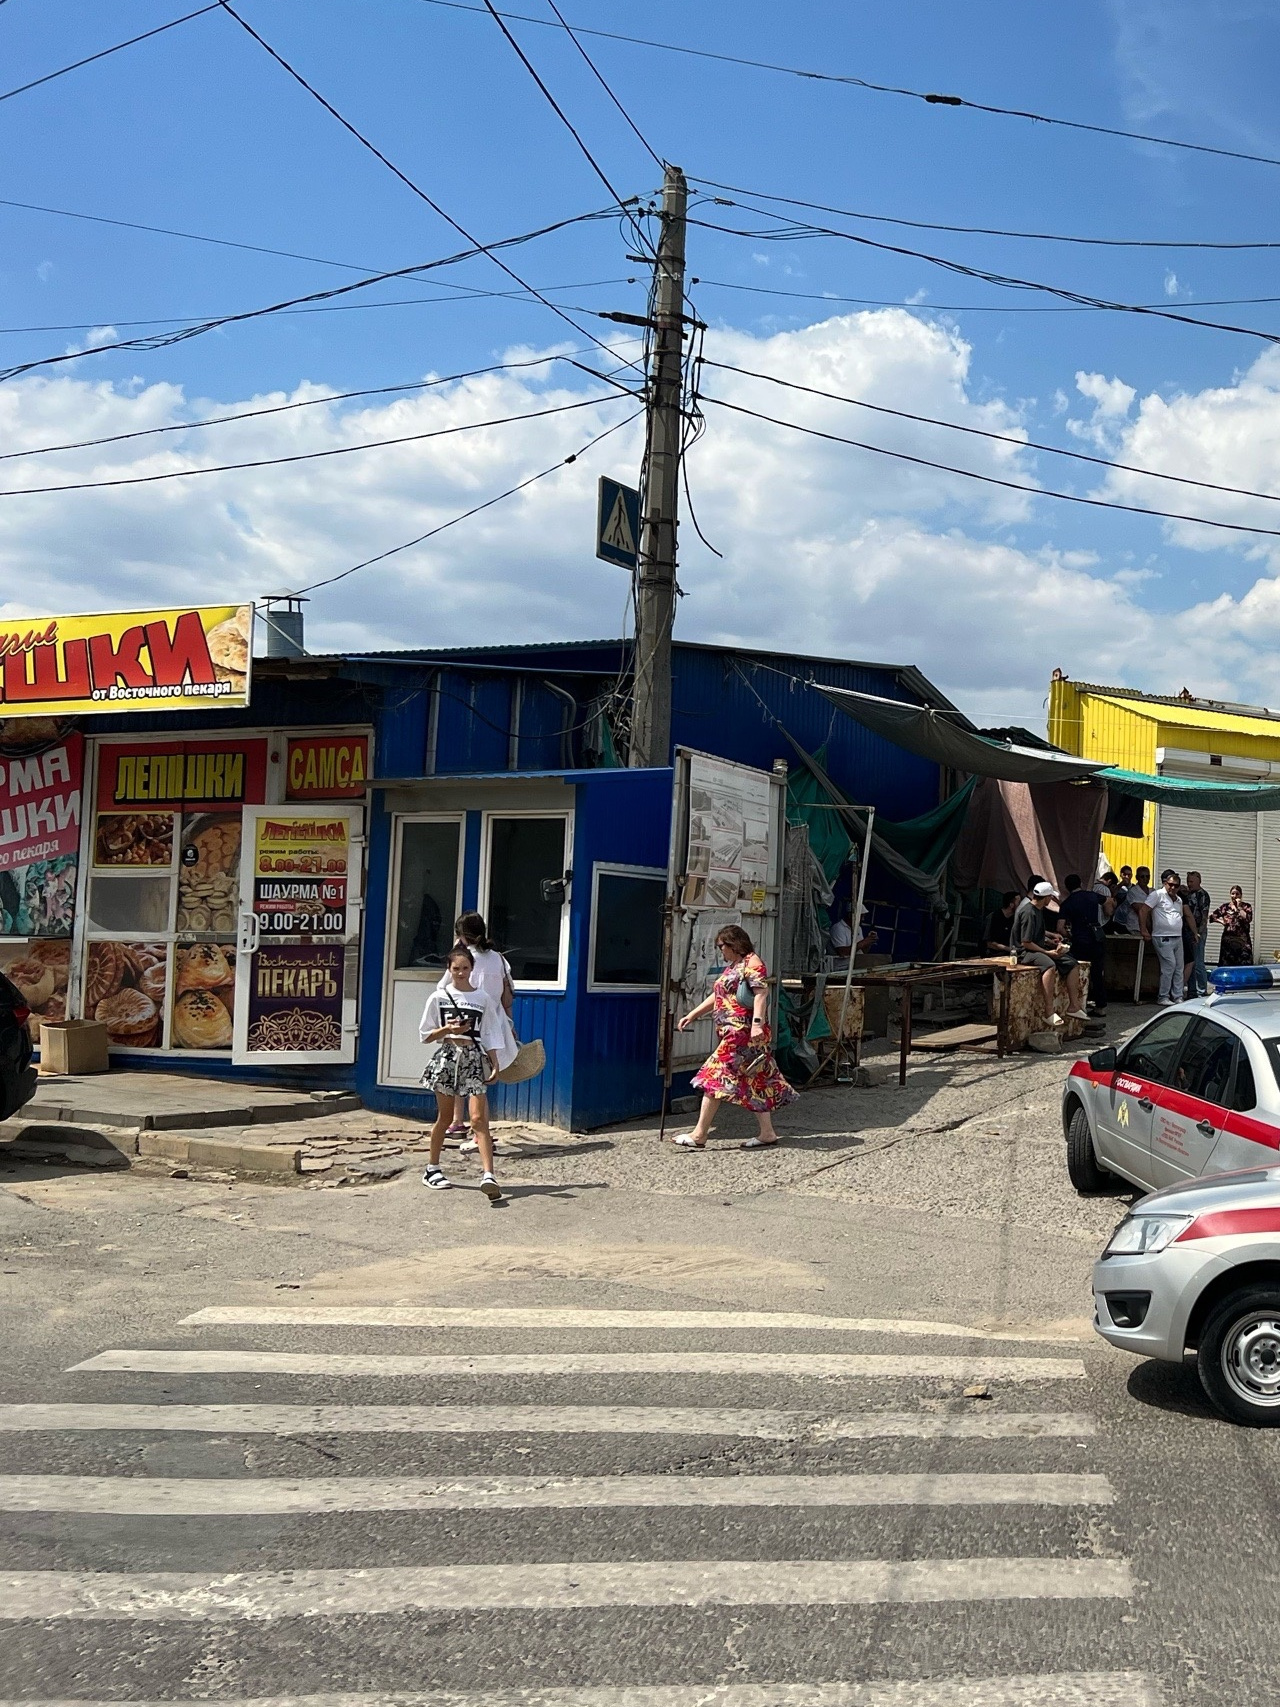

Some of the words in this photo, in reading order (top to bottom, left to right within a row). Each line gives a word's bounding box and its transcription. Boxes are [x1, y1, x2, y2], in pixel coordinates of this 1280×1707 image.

[0, 611, 216, 703] ШКИ
[92, 689, 107, 700] от
[109, 684, 182, 699] Восточного
[184, 682, 231, 698] пекаря
[290, 746, 364, 790] САМСА
[13, 839, 59, 860] пекаря
[260, 856, 346, 873] 8.00-21.00
[260, 884, 319, 899] ШАУРМА
[260, 913, 343, 930] 9.00-21.00
[258, 969, 337, 997] ПЕКАРЬ
